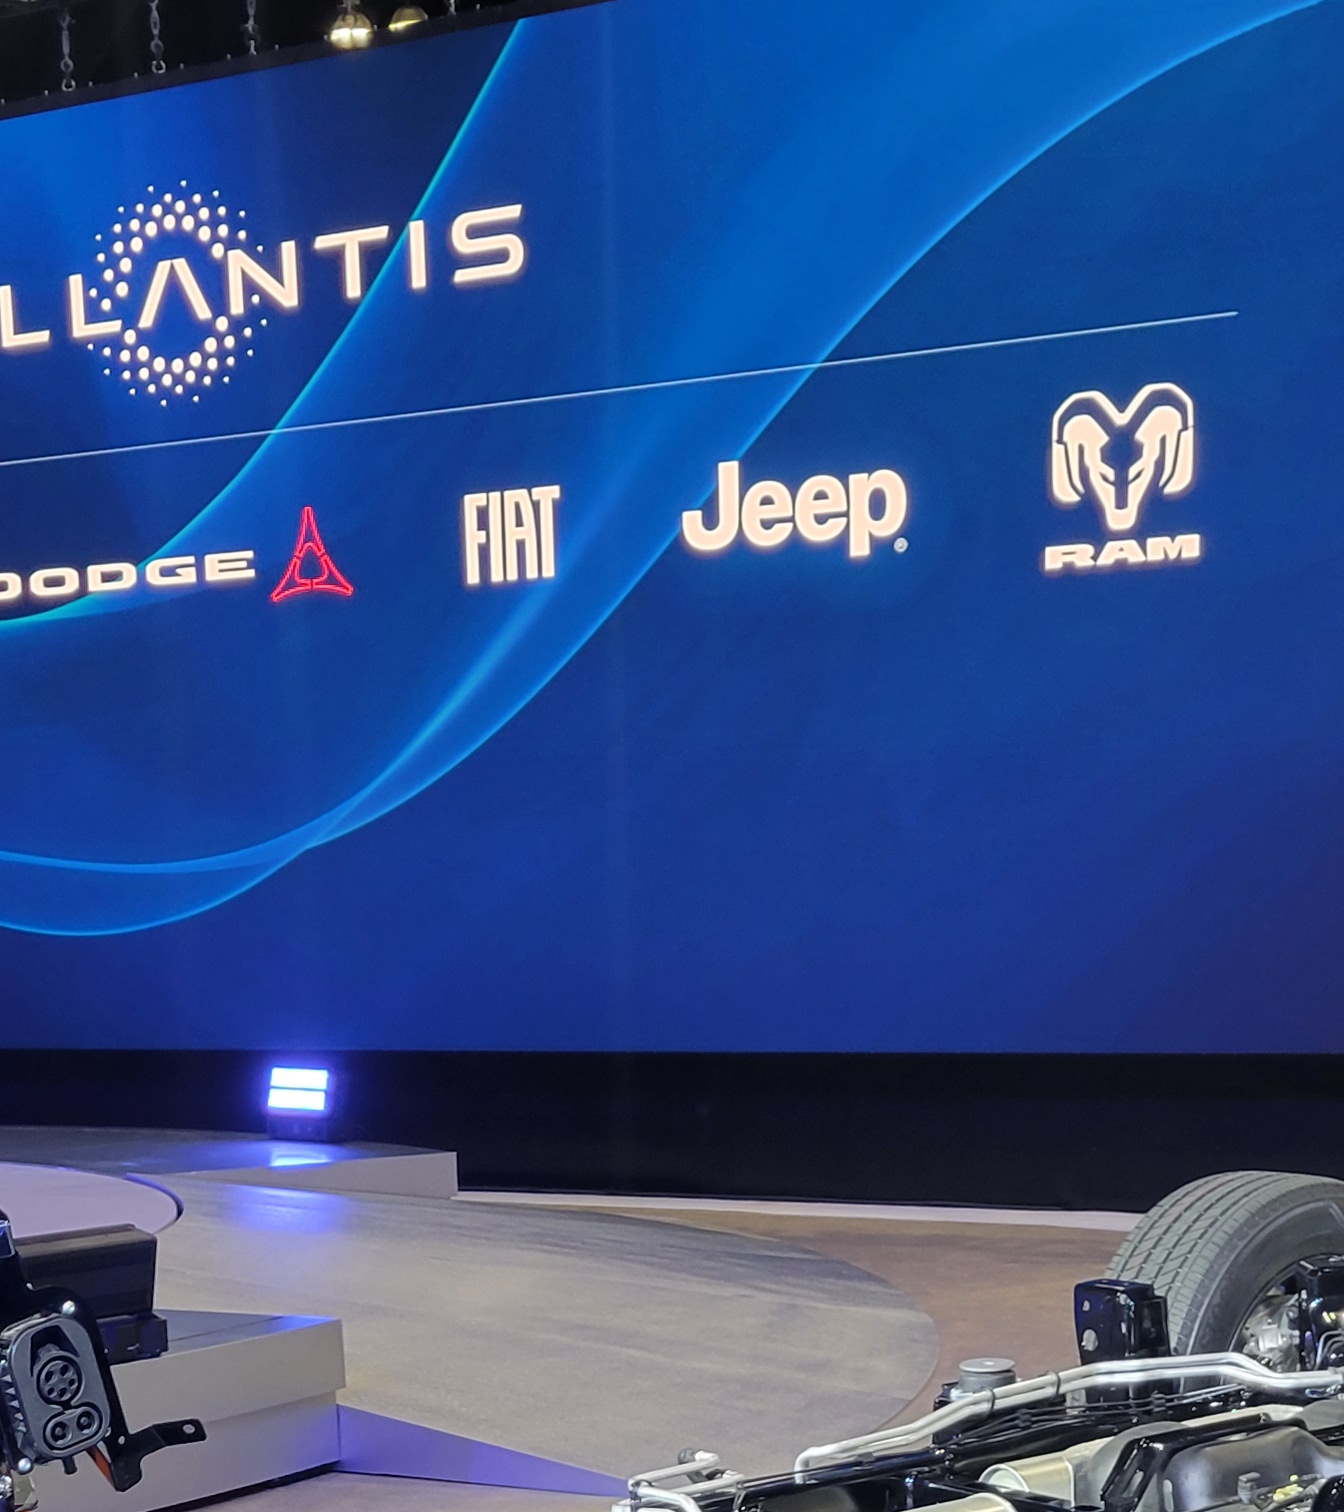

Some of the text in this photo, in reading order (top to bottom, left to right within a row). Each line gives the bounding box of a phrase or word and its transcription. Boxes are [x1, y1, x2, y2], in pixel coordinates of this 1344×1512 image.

[463, 485, 560, 585] FIAT
[682, 459, 909, 557] Jeep
[1044, 533, 1201, 570] RAM
